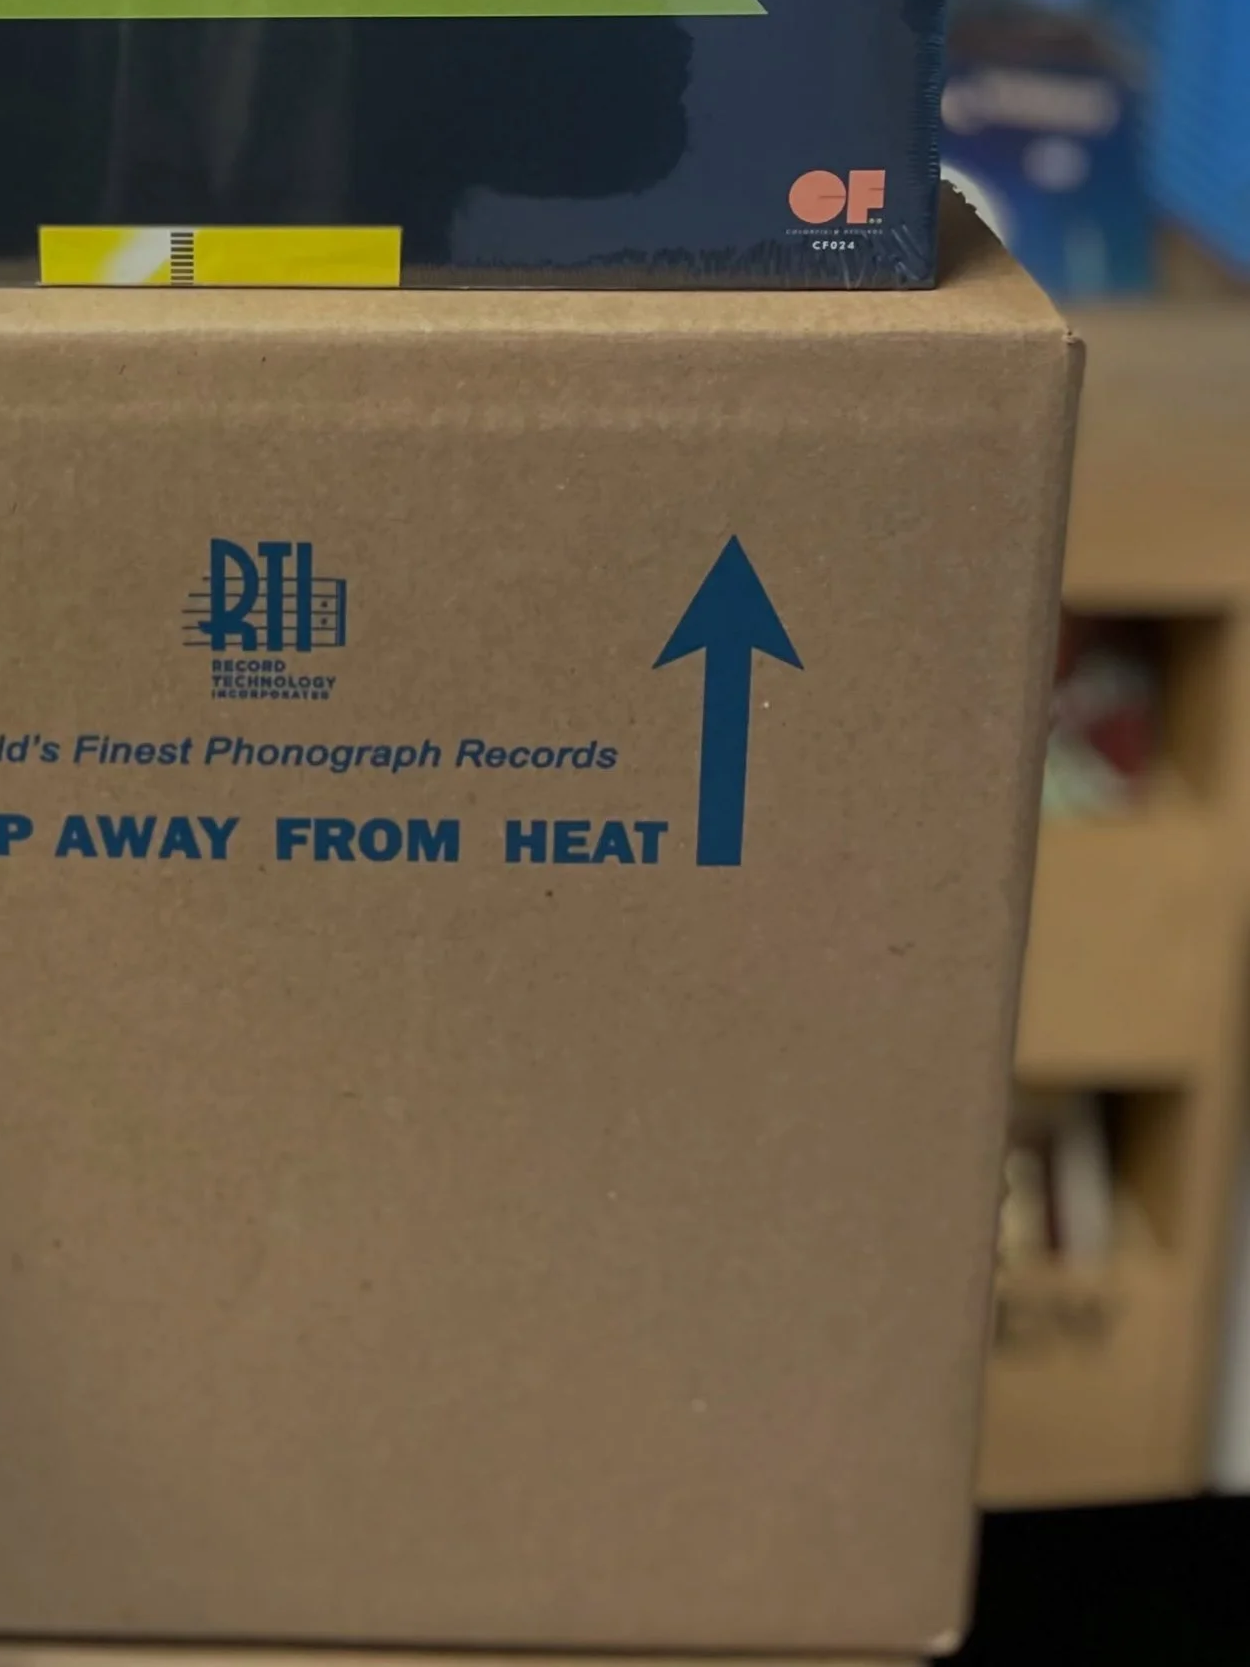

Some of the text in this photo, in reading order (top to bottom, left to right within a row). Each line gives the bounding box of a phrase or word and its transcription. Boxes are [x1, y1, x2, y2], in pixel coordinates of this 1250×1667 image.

[812, 240, 856, 251] CF024
[199, 538, 312, 652] RTI
[211, 659, 287, 673] RECORD
[211, 675, 337, 690] TECHNOLOGY
[211, 690, 331, 701] INCORPORATED
[73, 734, 193, 765] Finest
[204, 736, 442, 774] Phonograph
[455, 738, 618, 770] Records
[55, 814, 239, 859] AWAY
[275, 817, 460, 862] FROM
[505, 819, 668, 865] HEAT
